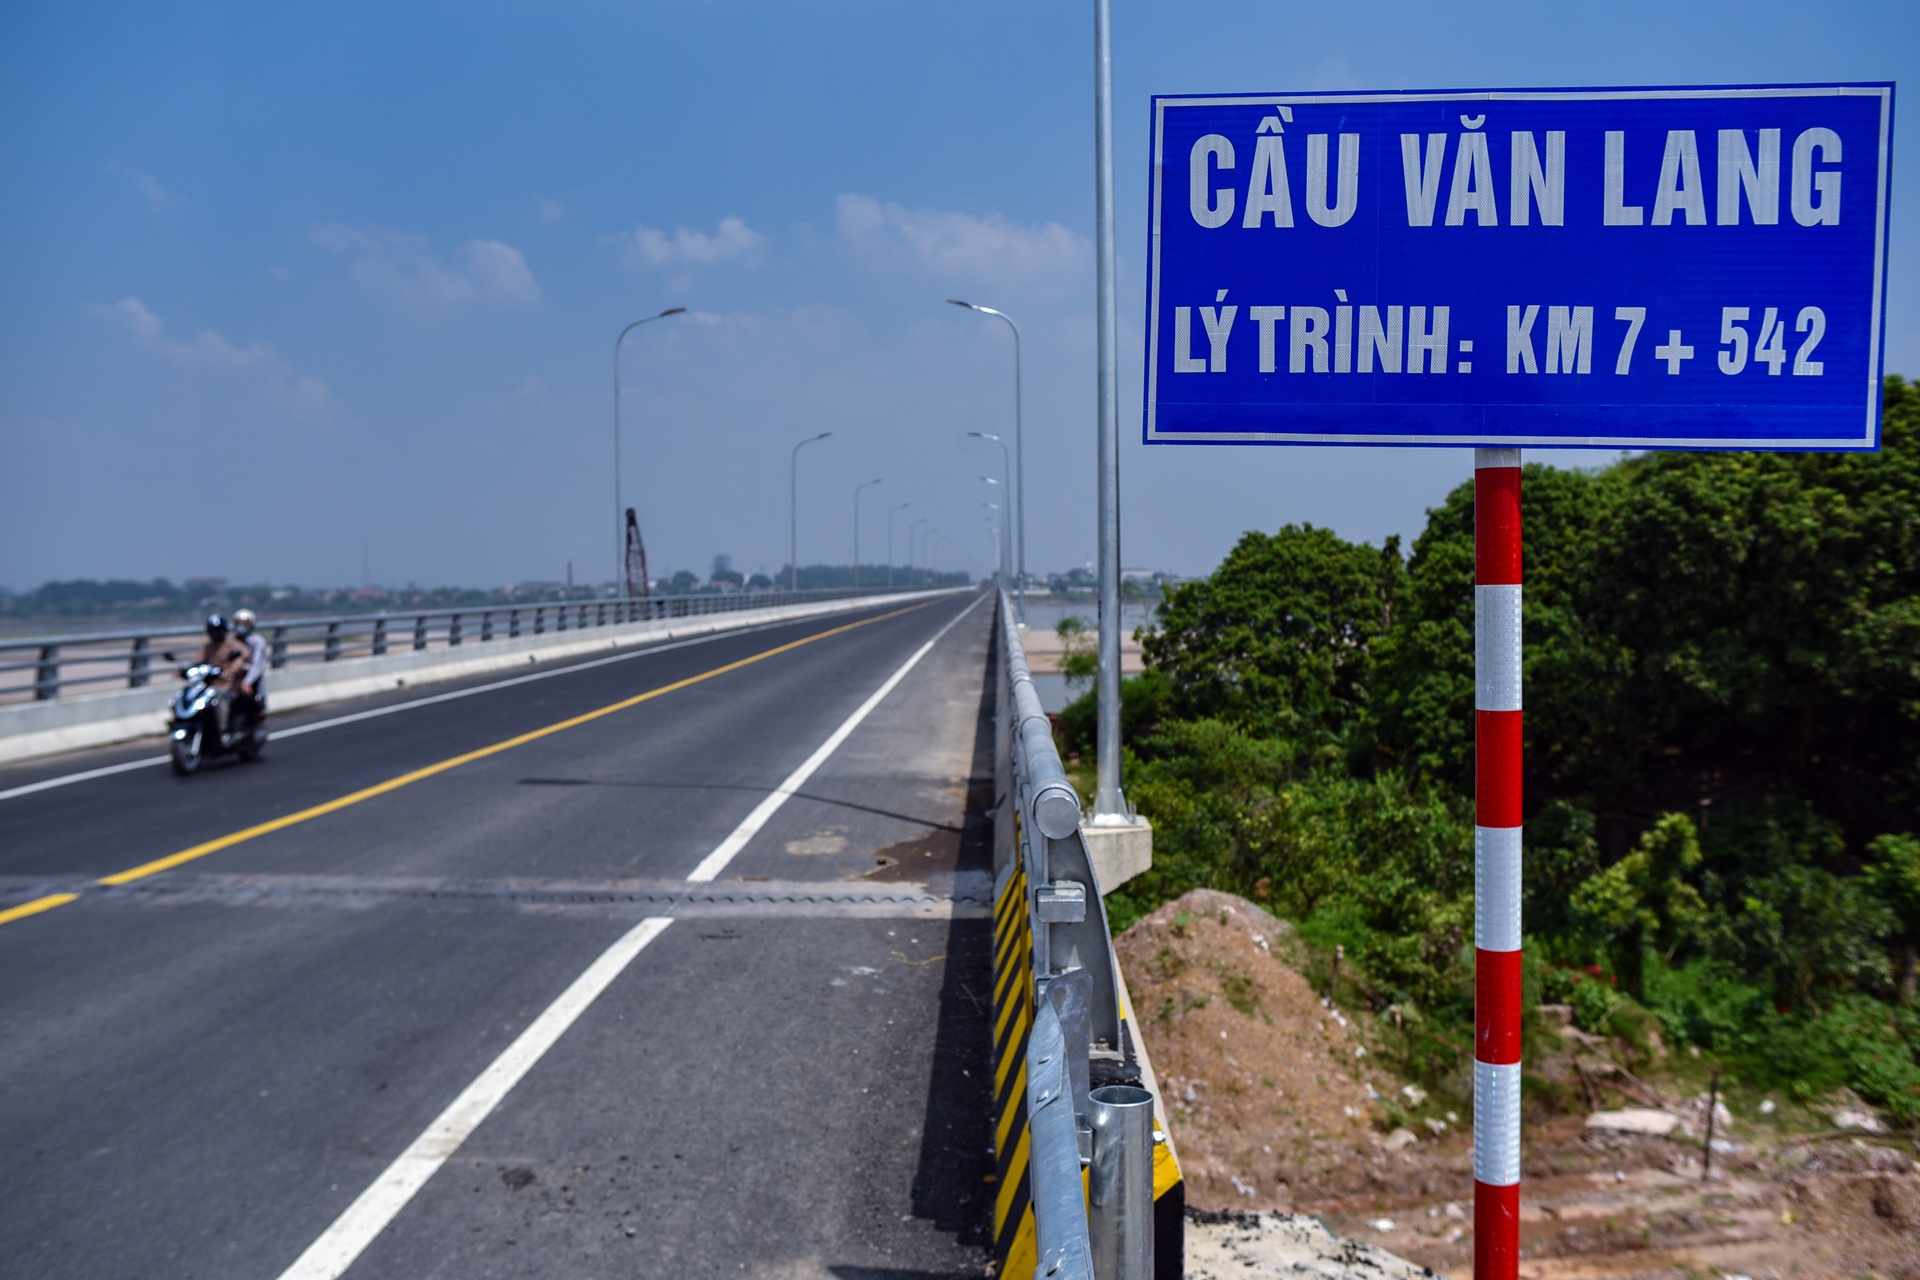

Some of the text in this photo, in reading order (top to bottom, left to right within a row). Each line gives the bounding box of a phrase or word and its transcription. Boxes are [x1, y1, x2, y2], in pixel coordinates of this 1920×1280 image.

[1189, 105, 1842, 229] CẦU VĂN LANG
[1174, 289, 1238, 373] LÝ
[1250, 289, 1472, 373] TRÌNH:
[1506, 304, 1594, 374] KM
[1717, 306, 1826, 376] 542
